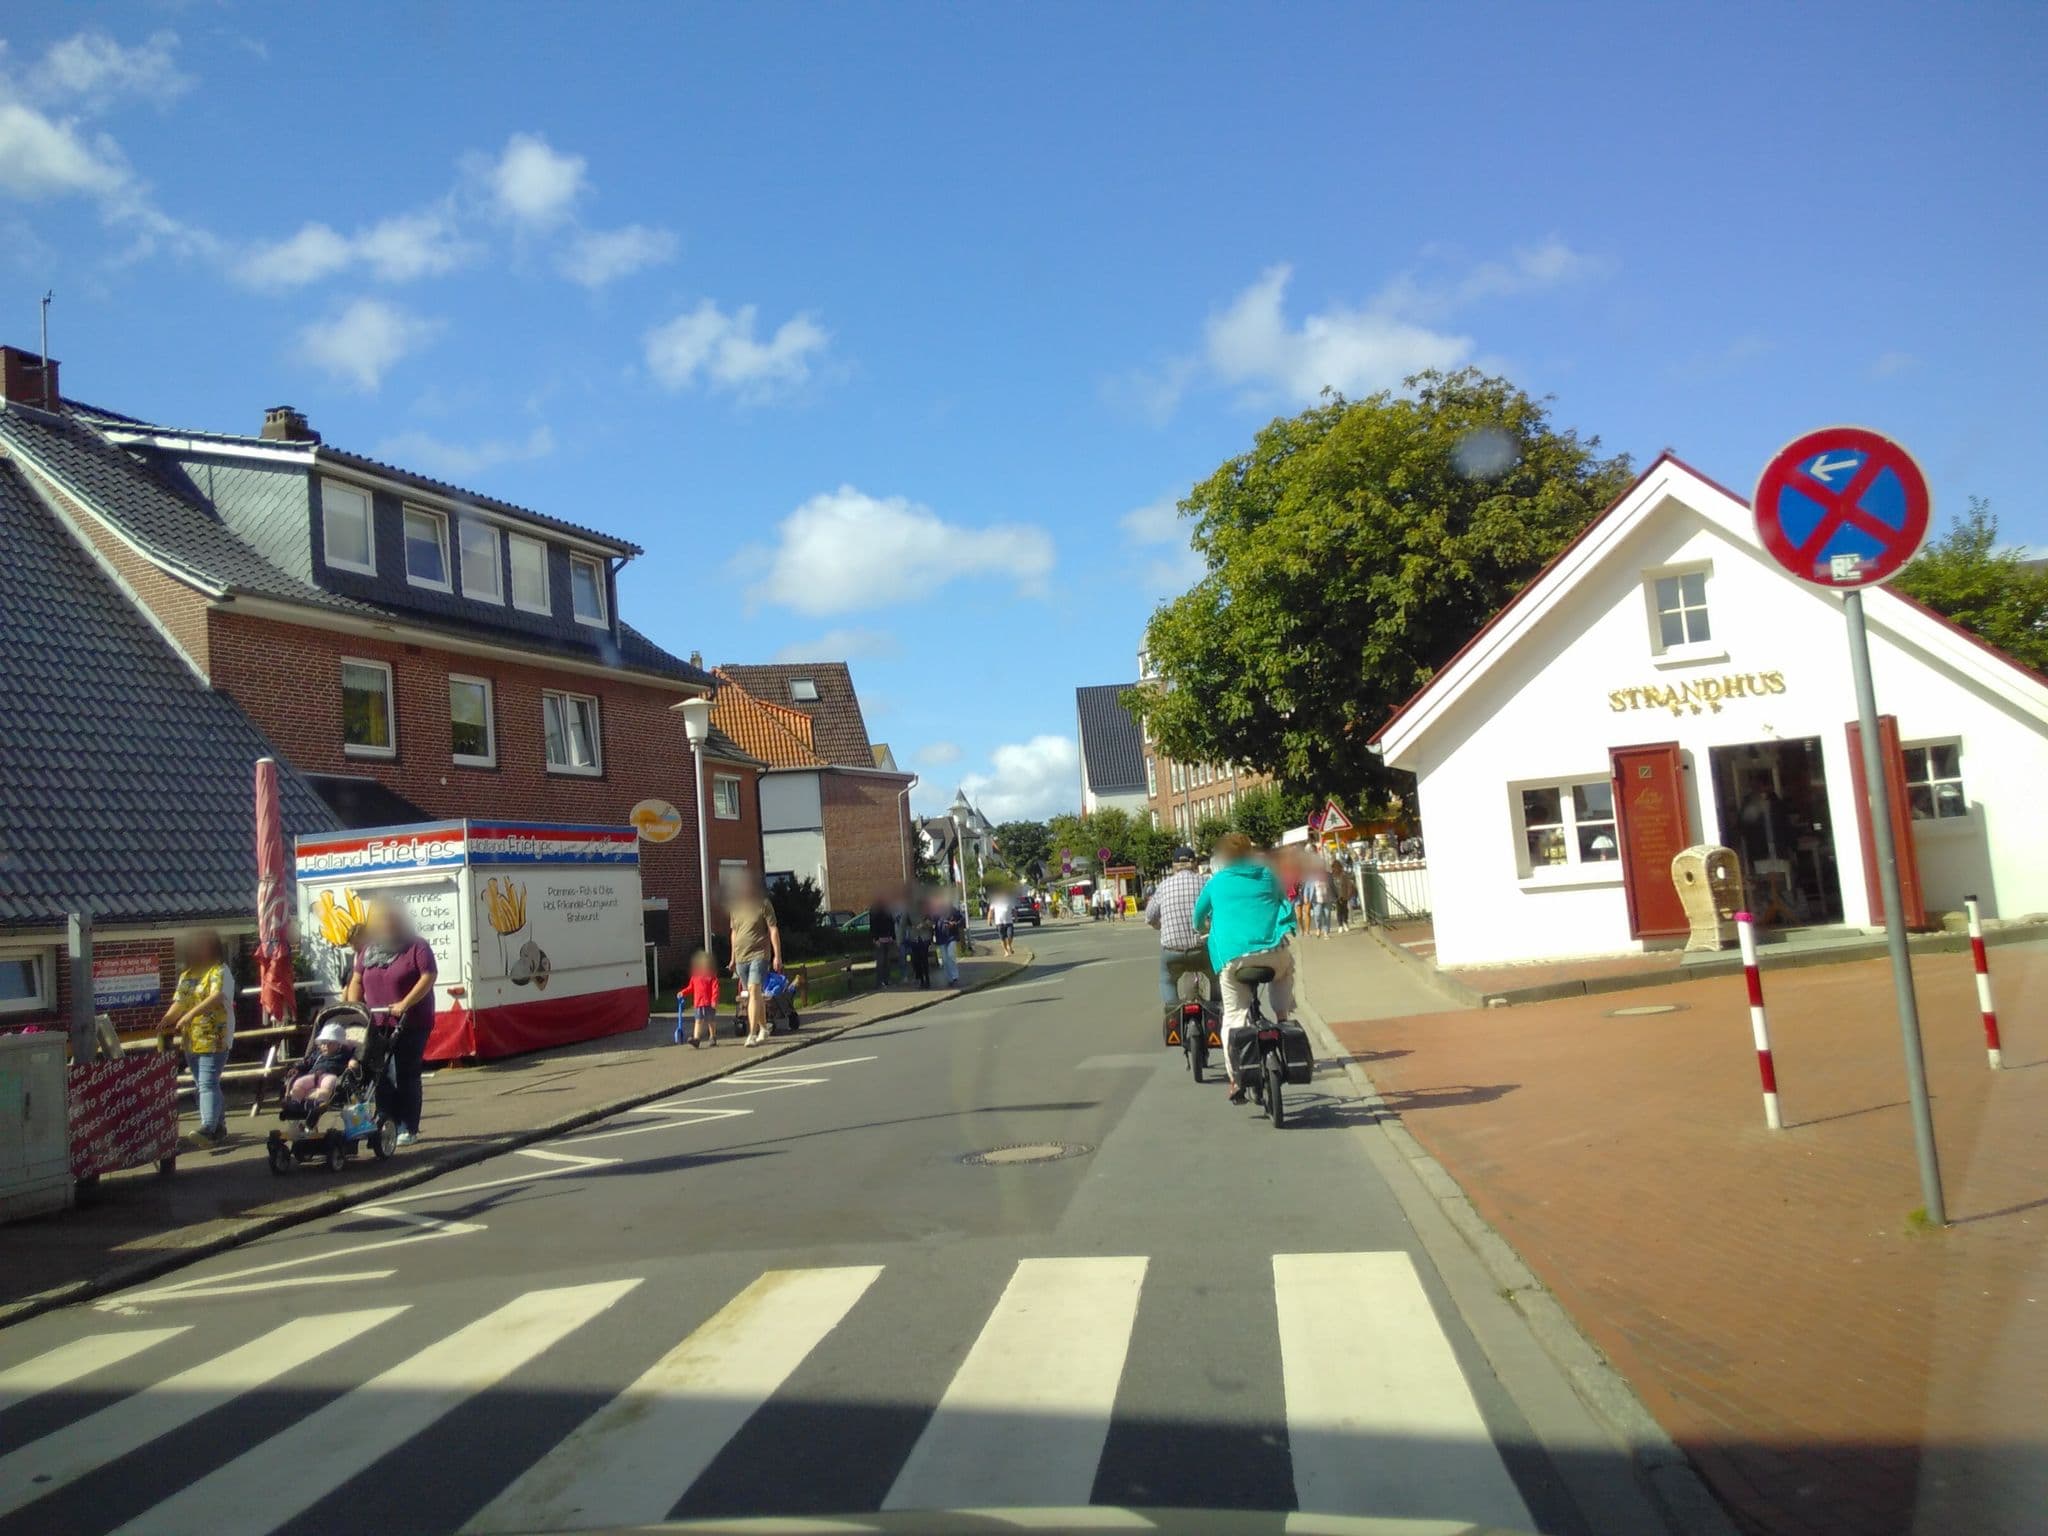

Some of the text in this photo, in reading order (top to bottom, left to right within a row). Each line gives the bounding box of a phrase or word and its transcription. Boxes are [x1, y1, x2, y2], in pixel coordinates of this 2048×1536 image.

[1608, 671, 1787, 712] STRANDHUS
[304, 837, 456, 871] Holland Frietjes
[421, 906, 450, 918] Chips
